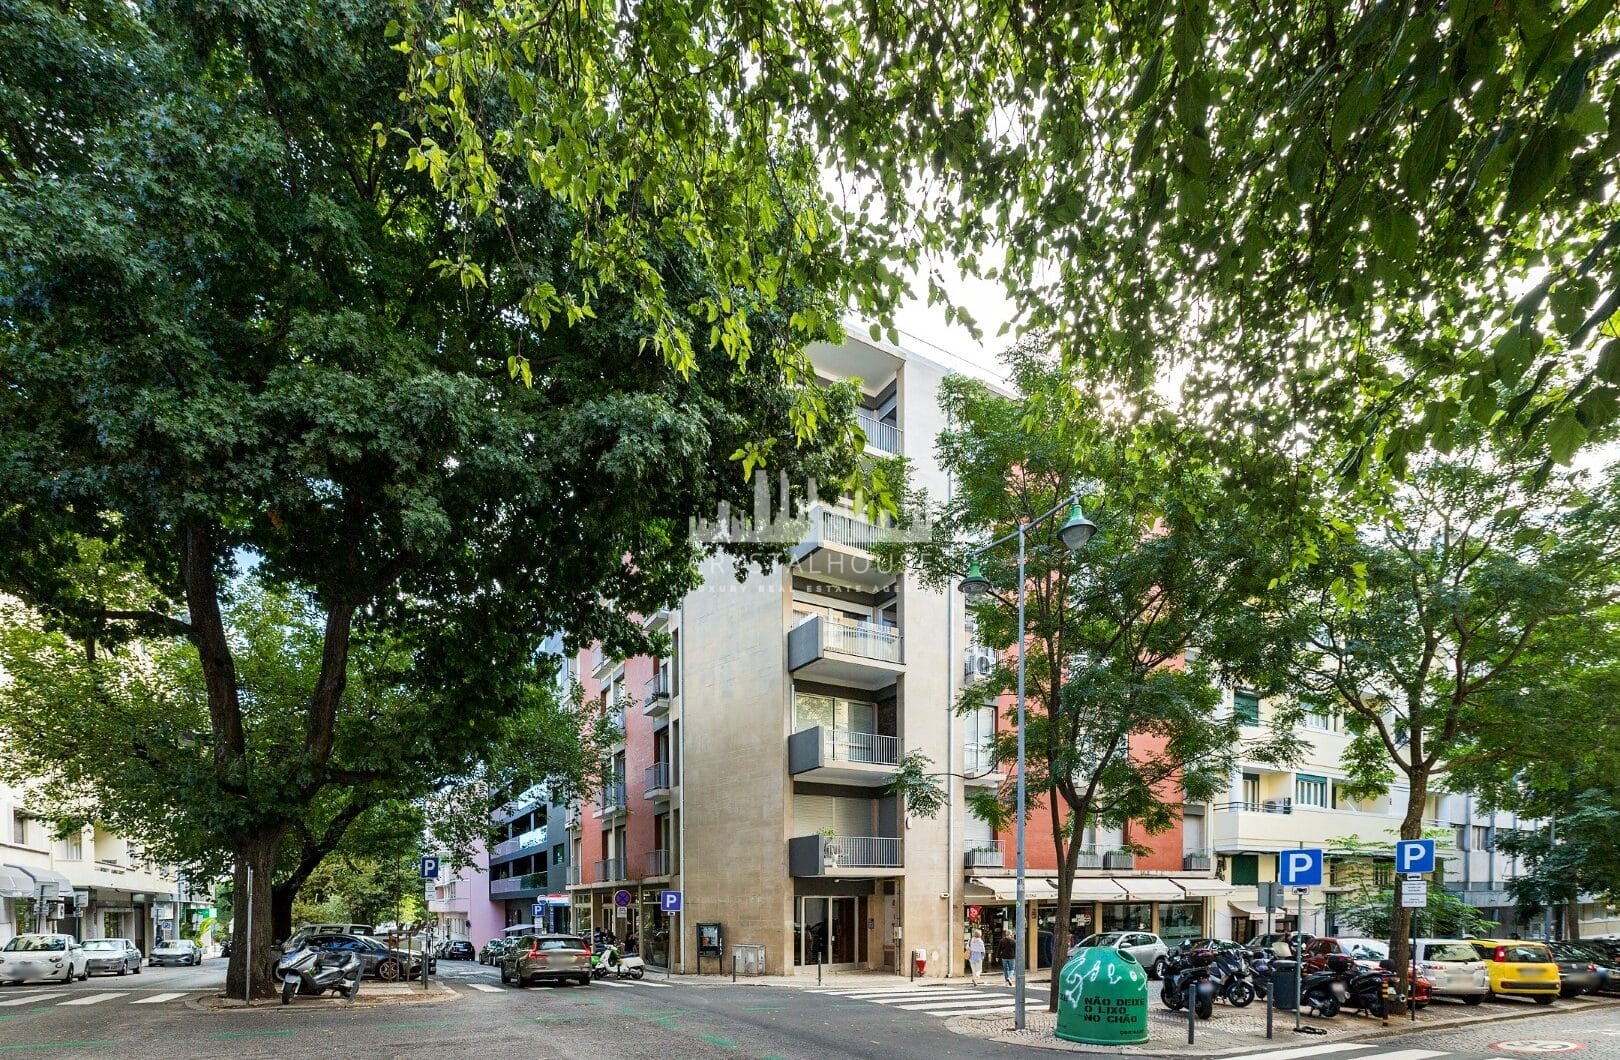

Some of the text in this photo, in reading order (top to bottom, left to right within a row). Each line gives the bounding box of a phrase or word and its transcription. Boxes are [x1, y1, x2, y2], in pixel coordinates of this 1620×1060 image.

[1404, 844, 1425, 869] P
[425, 860, 436, 876] P
[1289, 854, 1312, 882] P
[666, 895, 677, 908] P
[535, 906, 542, 915] P
[1084, 996, 1110, 1006] NÃO
[1099, 1006, 1127, 1014] LIXO
[1084, 1014, 1100, 1023] NO
